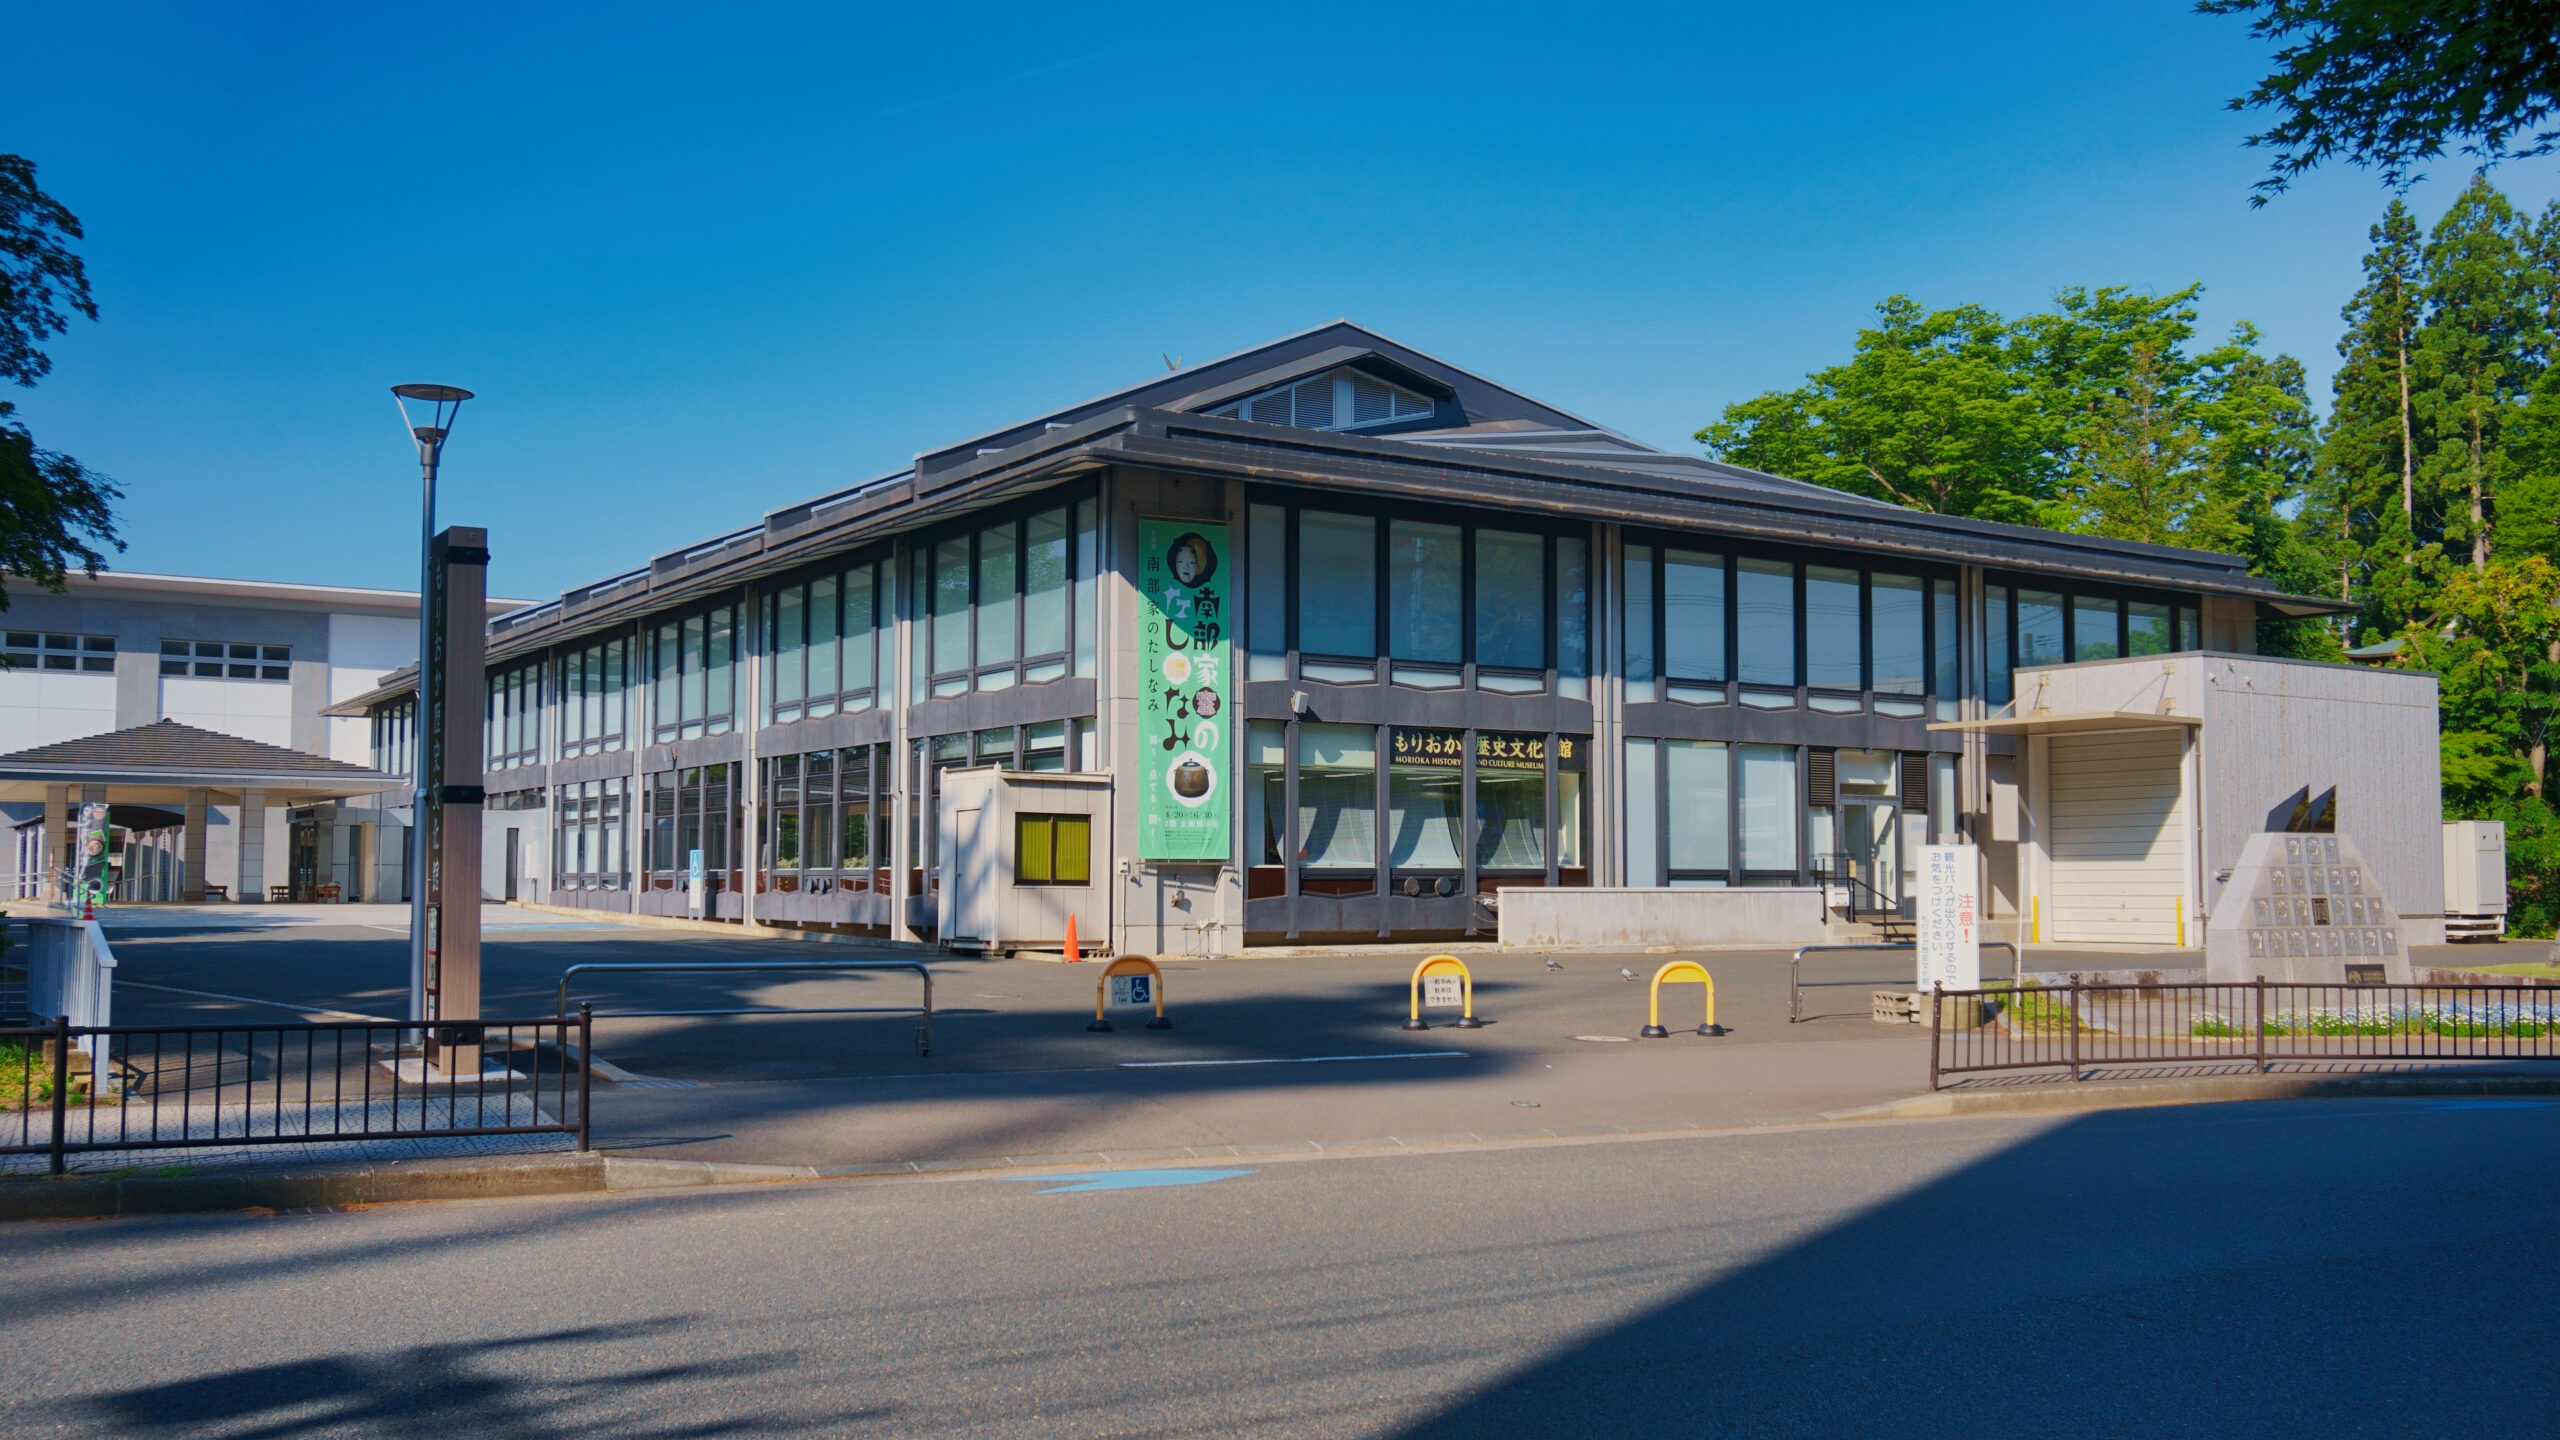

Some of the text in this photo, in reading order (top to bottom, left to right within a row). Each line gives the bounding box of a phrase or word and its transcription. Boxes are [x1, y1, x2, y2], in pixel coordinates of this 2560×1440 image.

[1147, 555, 1160, 712] 南部家のたしなみ
[1395, 756, 1430, 766] MORIOKA
[1432, 757, 1462, 767] HISTORY
[1489, 760, 1515, 768] CULTURE
[1516, 761, 1544, 769] MUSEUM
[1931, 852, 1943, 957] お気をつけください。
[1944, 852, 1957, 985] 観光バスが出入りするので
[1958, 893, 1974, 944] 注意！
